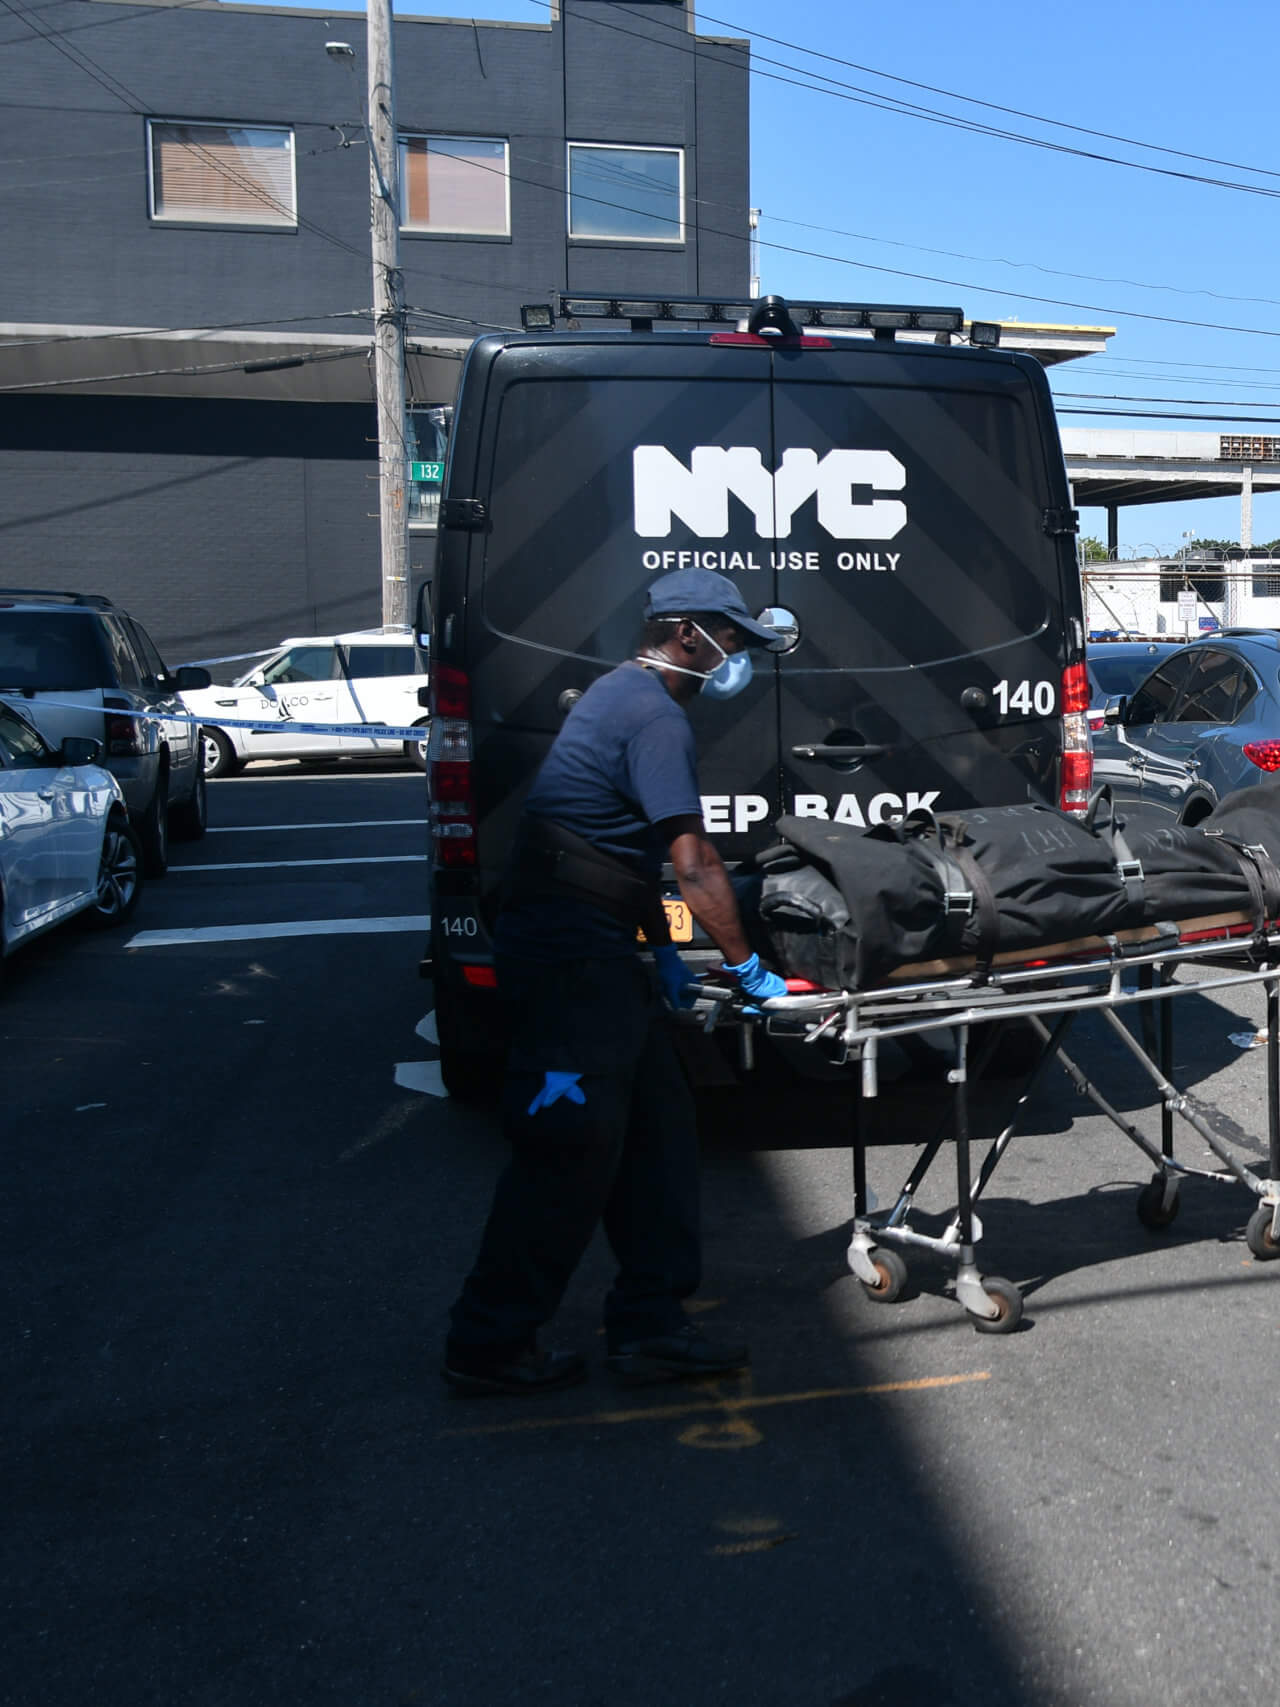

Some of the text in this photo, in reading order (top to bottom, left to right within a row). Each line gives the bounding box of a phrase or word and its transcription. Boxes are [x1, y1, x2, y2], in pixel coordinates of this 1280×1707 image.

[420, 463, 440, 479] 132
[633, 445, 908, 540] NYC
[642, 550, 901, 572] OFFICIAL USE ONLY
[992, 679, 1055, 716] 140
[700, 794, 769, 833] EP
[795, 791, 942, 828] BACK
[440, 916, 478, 937] 140
